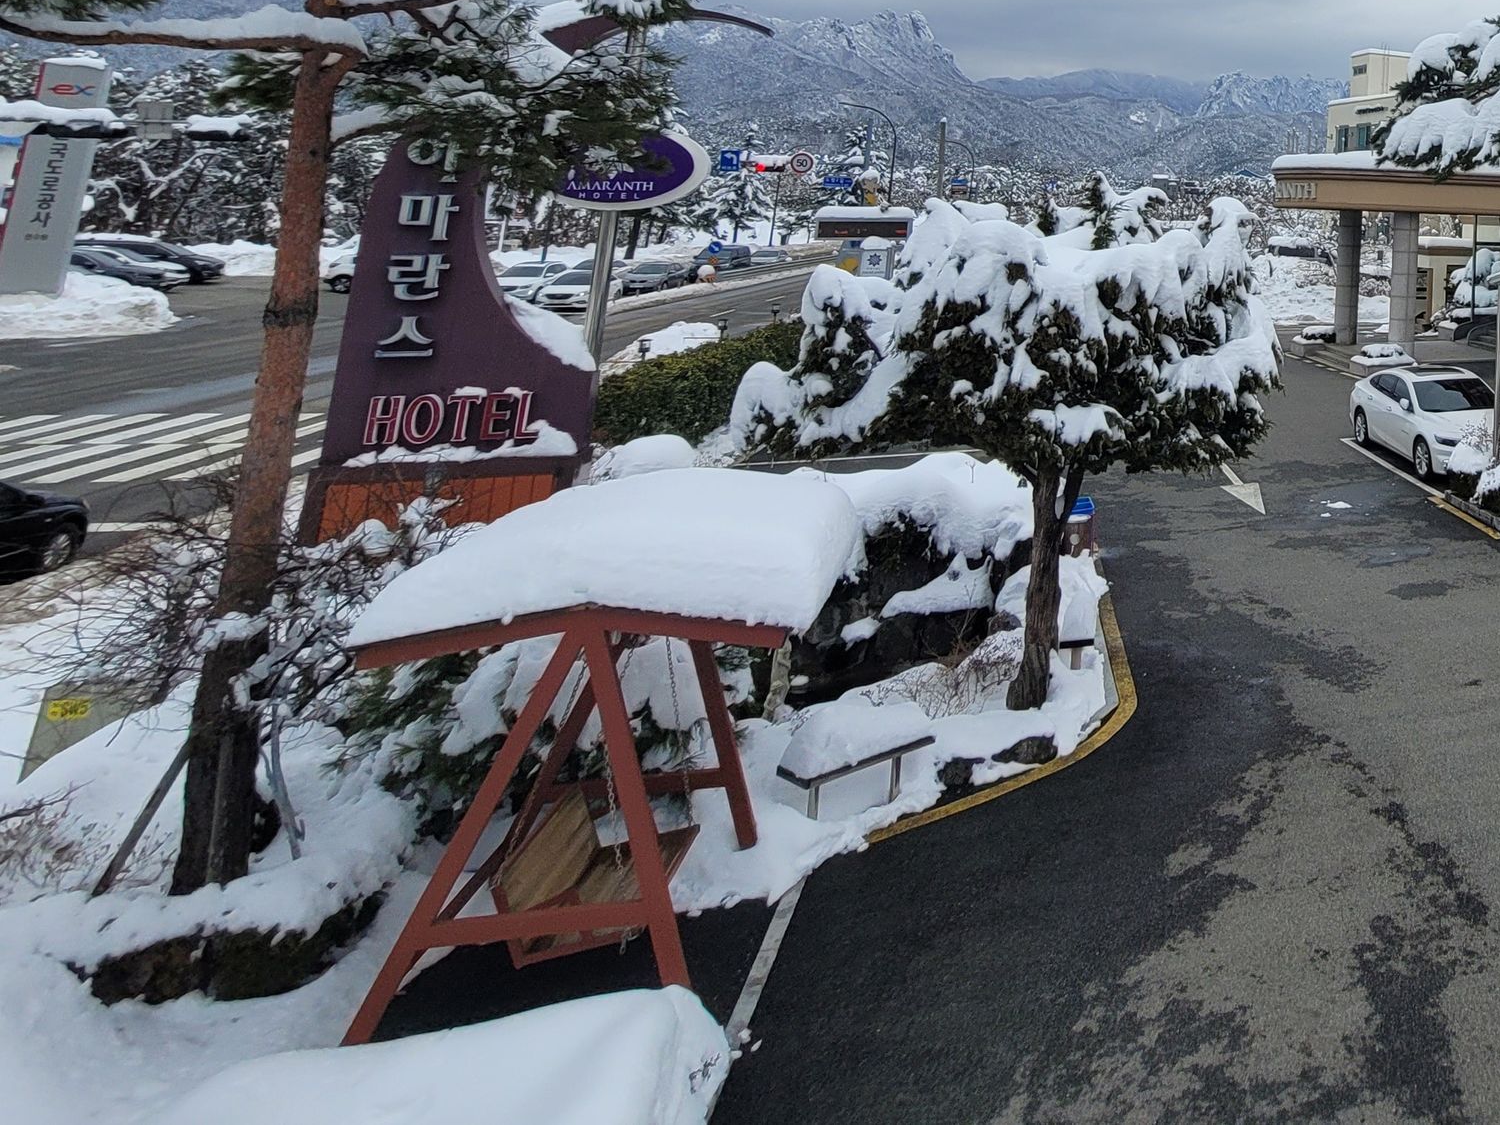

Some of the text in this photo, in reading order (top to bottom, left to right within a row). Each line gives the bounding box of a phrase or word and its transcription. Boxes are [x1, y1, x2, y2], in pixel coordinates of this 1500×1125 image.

[796, 158, 808, 168] 50
[30, 136, 68, 229] 국도로공사
[566, 181, 654, 192] AMARANTH
[578, 192, 640, 200] HOTEL
[363, 388, 541, 445] HOTEL
